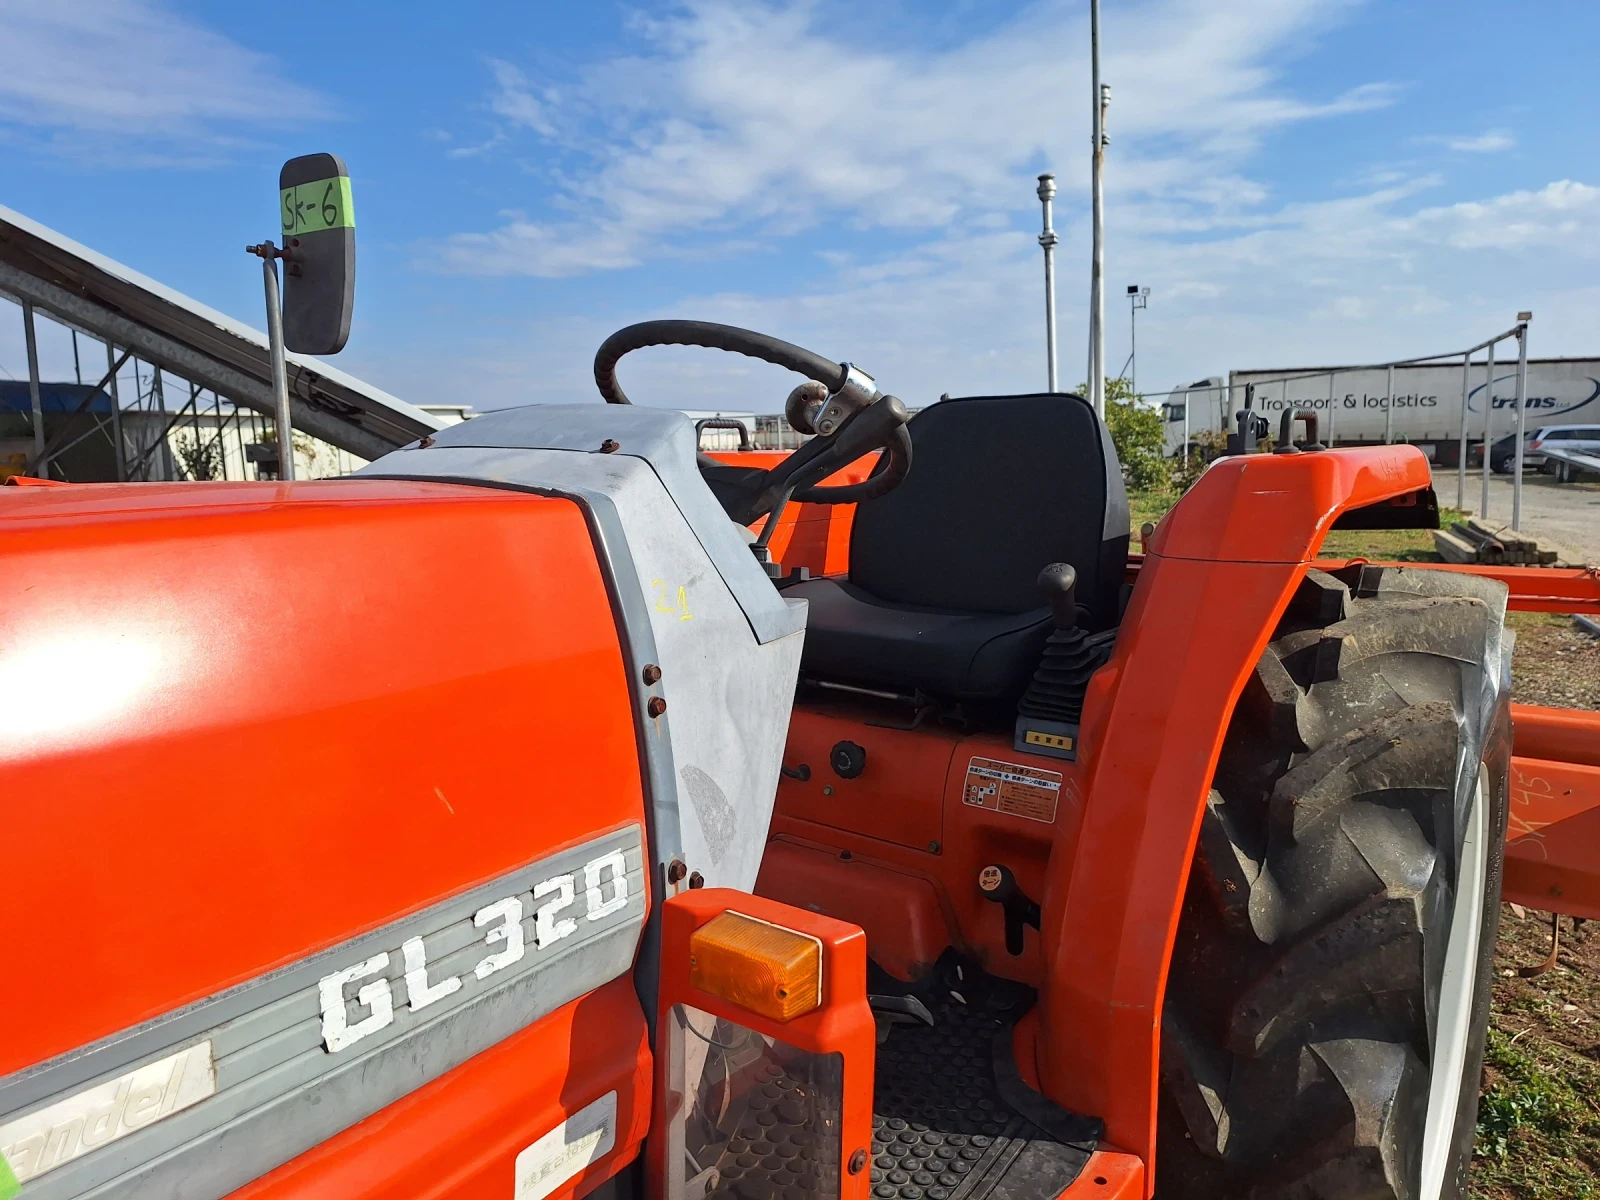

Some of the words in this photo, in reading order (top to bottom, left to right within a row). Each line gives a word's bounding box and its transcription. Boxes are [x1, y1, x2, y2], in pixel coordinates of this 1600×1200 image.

[1343, 393, 1357, 409] &
[1363, 393, 1437, 412] logistics
[651, 579, 694, 621] 21
[318, 847, 629, 1054] GL320
[1, 1052, 190, 1183] andel
